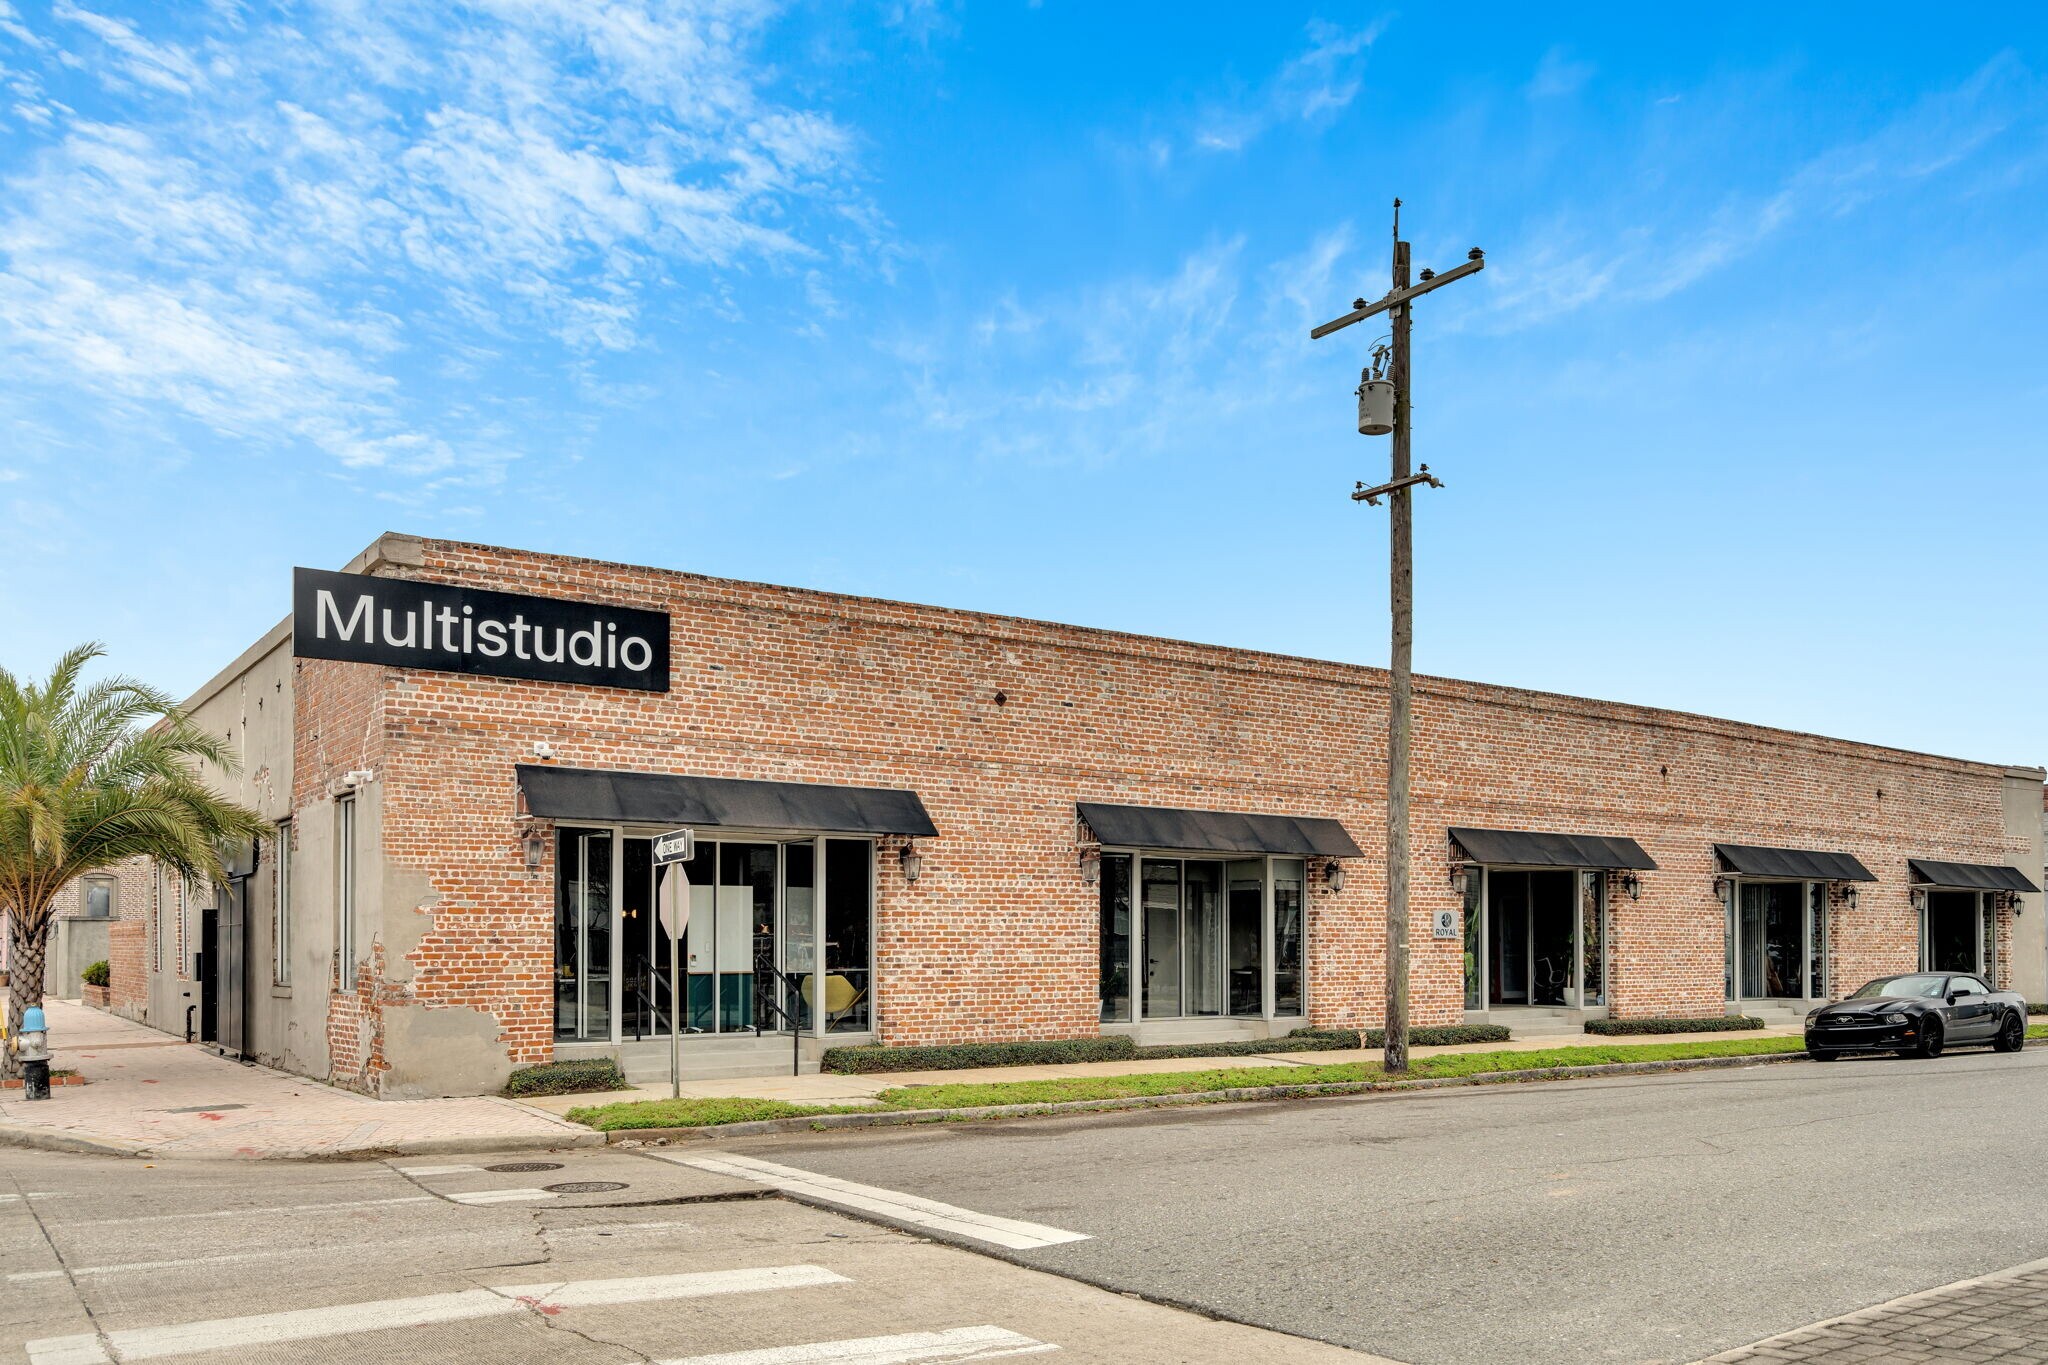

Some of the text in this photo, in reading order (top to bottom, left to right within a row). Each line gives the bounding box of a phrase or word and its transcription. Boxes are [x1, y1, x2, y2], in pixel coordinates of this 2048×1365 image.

[316, 589, 653, 672] Multistudio
[663, 839, 683, 854] ONE WAY
[1435, 928, 1457, 937] ROYAL
